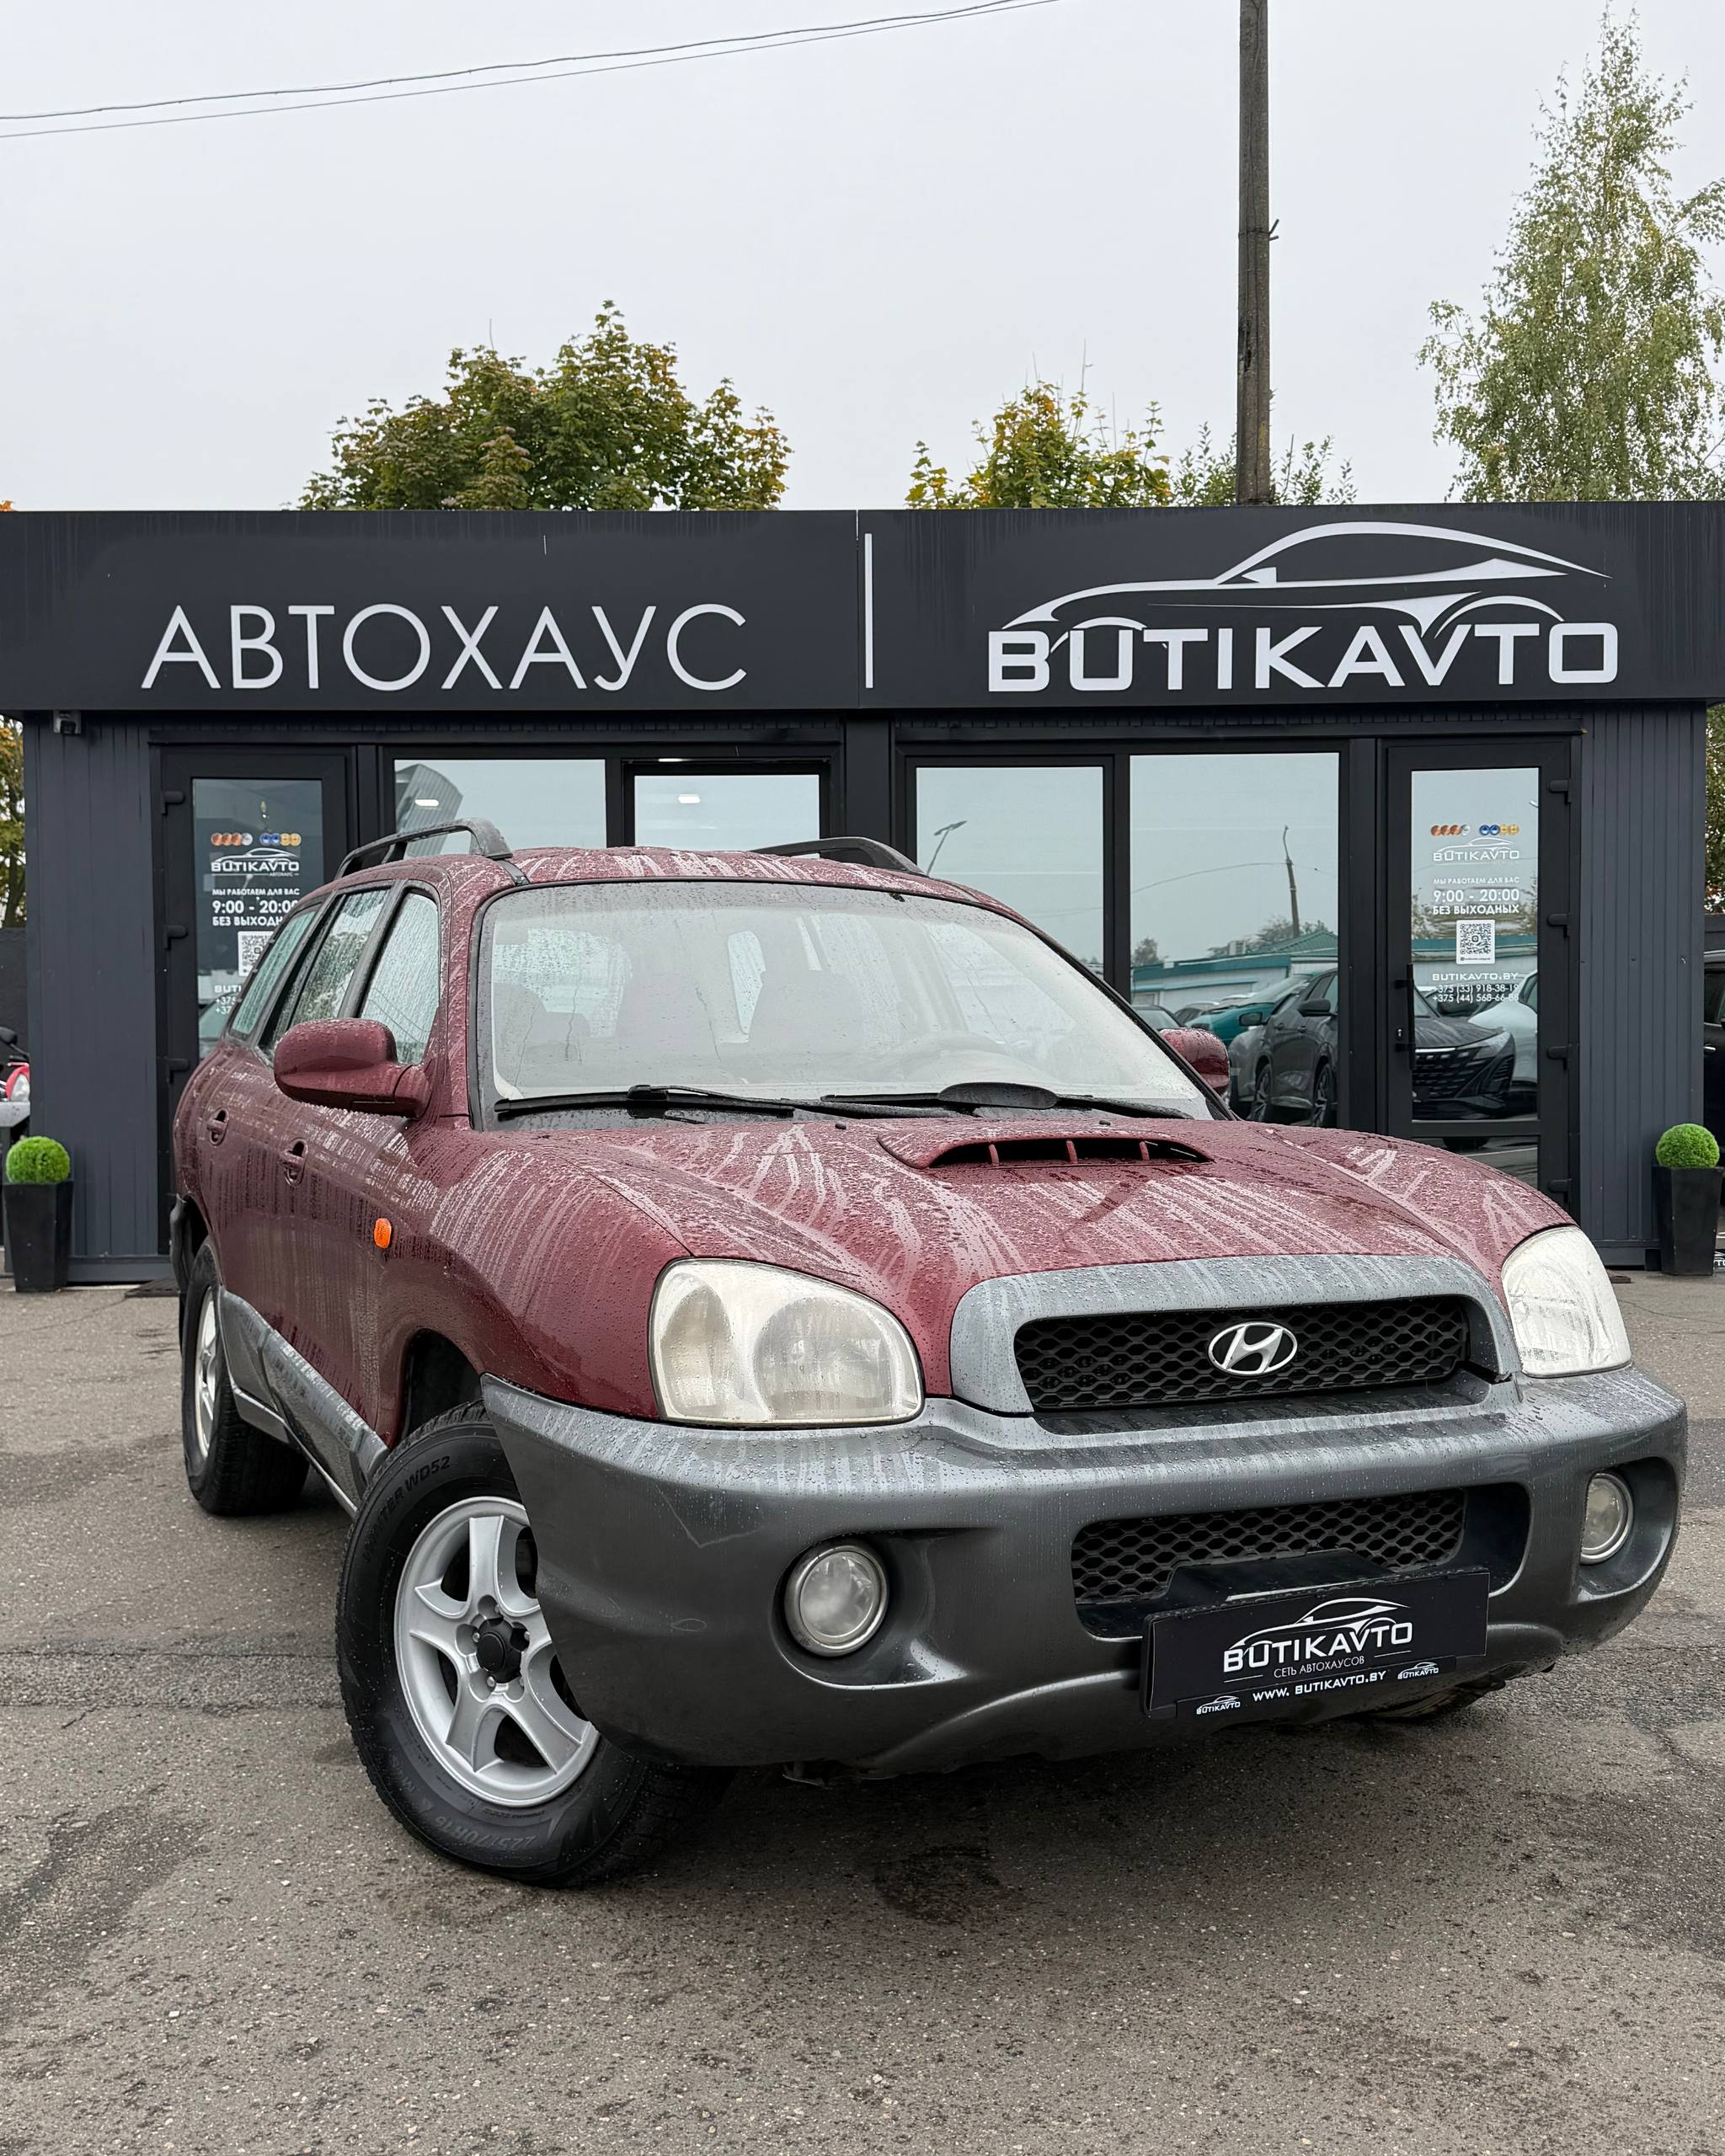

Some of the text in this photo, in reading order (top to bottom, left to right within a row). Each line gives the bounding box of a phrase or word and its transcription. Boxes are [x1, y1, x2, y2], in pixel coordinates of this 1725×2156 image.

[141, 603, 747, 691] АВТОХАУС
[988, 622, 1618, 693] BUTIKAVTO
[1433, 850, 1520, 862] BUTIKAVTO
[211, 862, 300, 873] BUTIKAVTO
[1434, 890, 1464, 903] 9:00
[1479, 889, 1519, 901] 20:00
[212, 900, 244, 914] 9:00
[1433, 905, 1519, 915] БЕЗ ВЫХОДНЫХ
[212, 916, 232, 926] БЕЗ
[1432, 973, 1519, 981] BUTIKAVTO.BY
[1456, 984, 1474, 994] (33)
[1456, 994, 1474, 1004] (44)
[405, 1456, 451, 1492] WD52
[1223, 1621, 1413, 1673] BUTIKAVTO
[1274, 1655, 1365, 1679] СЕТЬ АВТОХАУСОВ
[1397, 1667, 1439, 1680] BUTIKAVTO
[1295, 1671, 1387, 1695] BUTIKAVTO.BY
[1196, 1701, 1242, 1716] BUTIKAVTO
